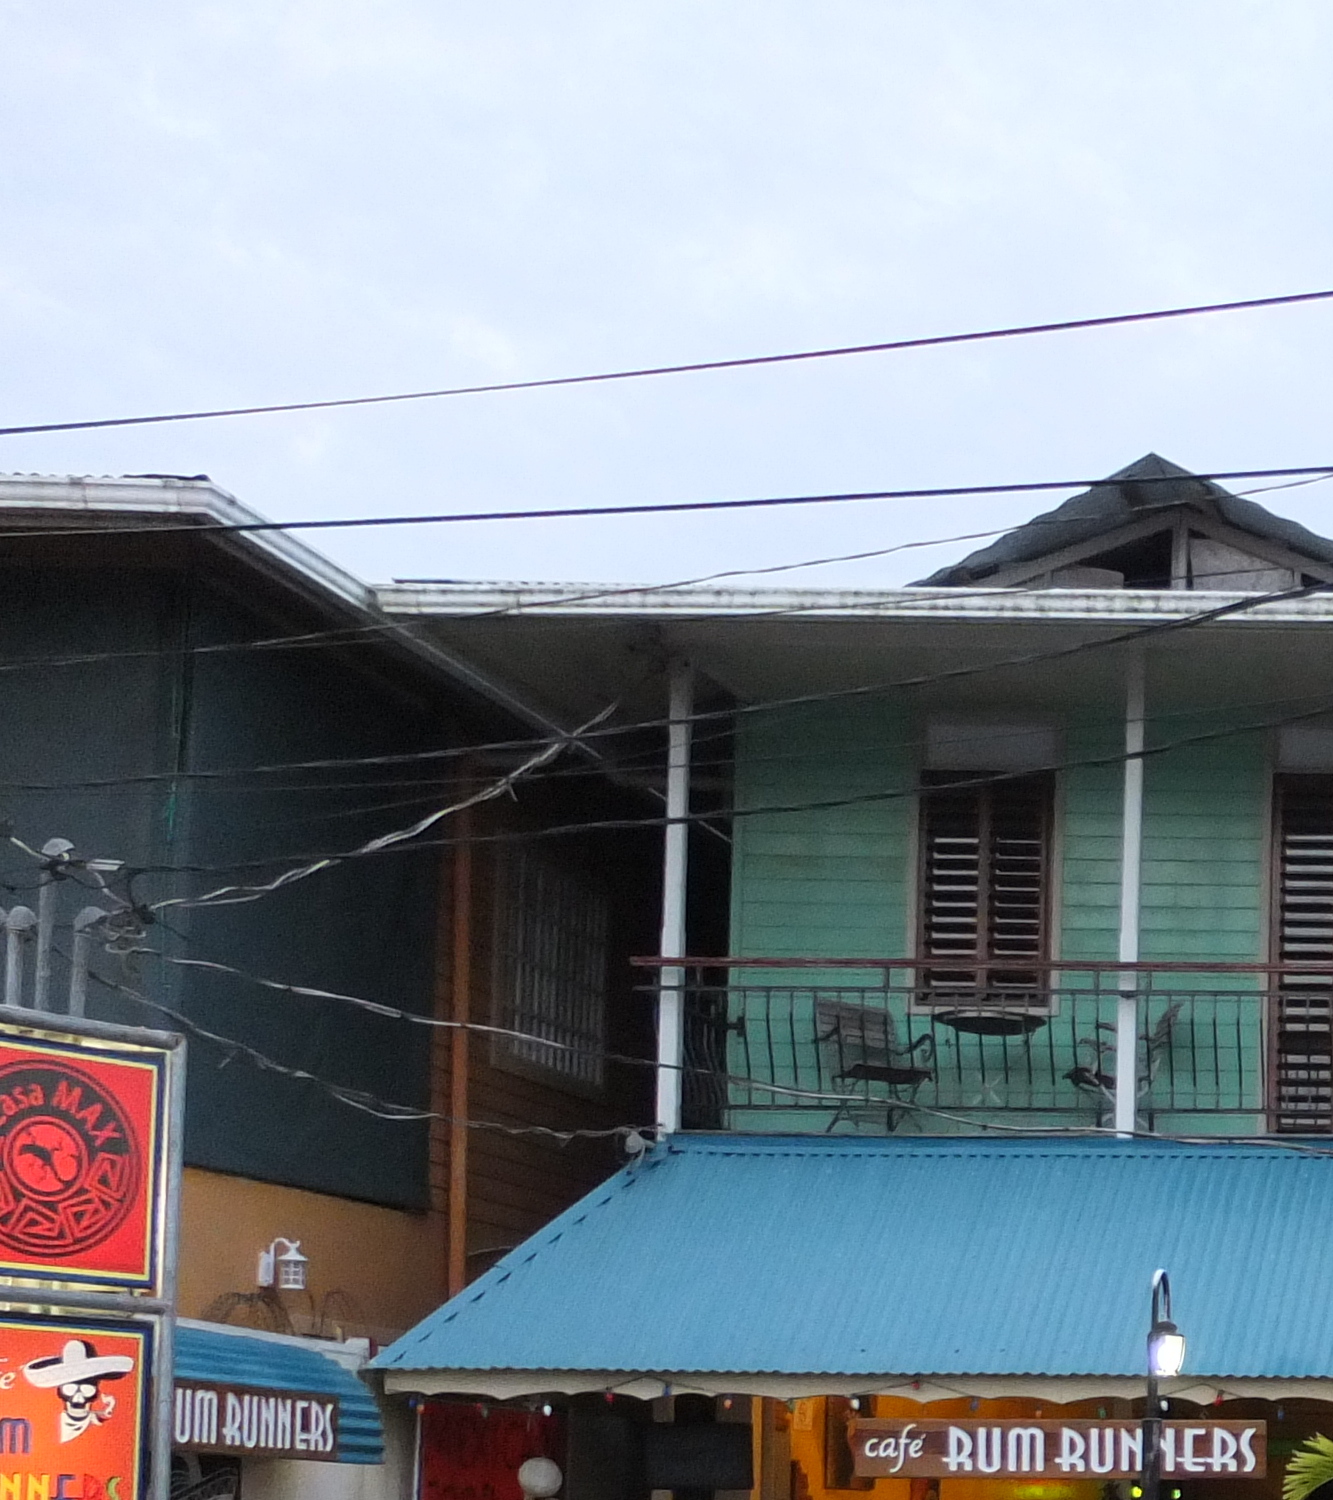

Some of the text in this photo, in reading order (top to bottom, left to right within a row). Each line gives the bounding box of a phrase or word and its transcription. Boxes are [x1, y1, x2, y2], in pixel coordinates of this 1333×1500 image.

[0, 1080, 121, 1146] asa MAX
[174, 1388, 334, 1452] UM RUNNERS
[864, 1423, 924, 1474] café
[942, 1427, 1045, 1473] RUM
